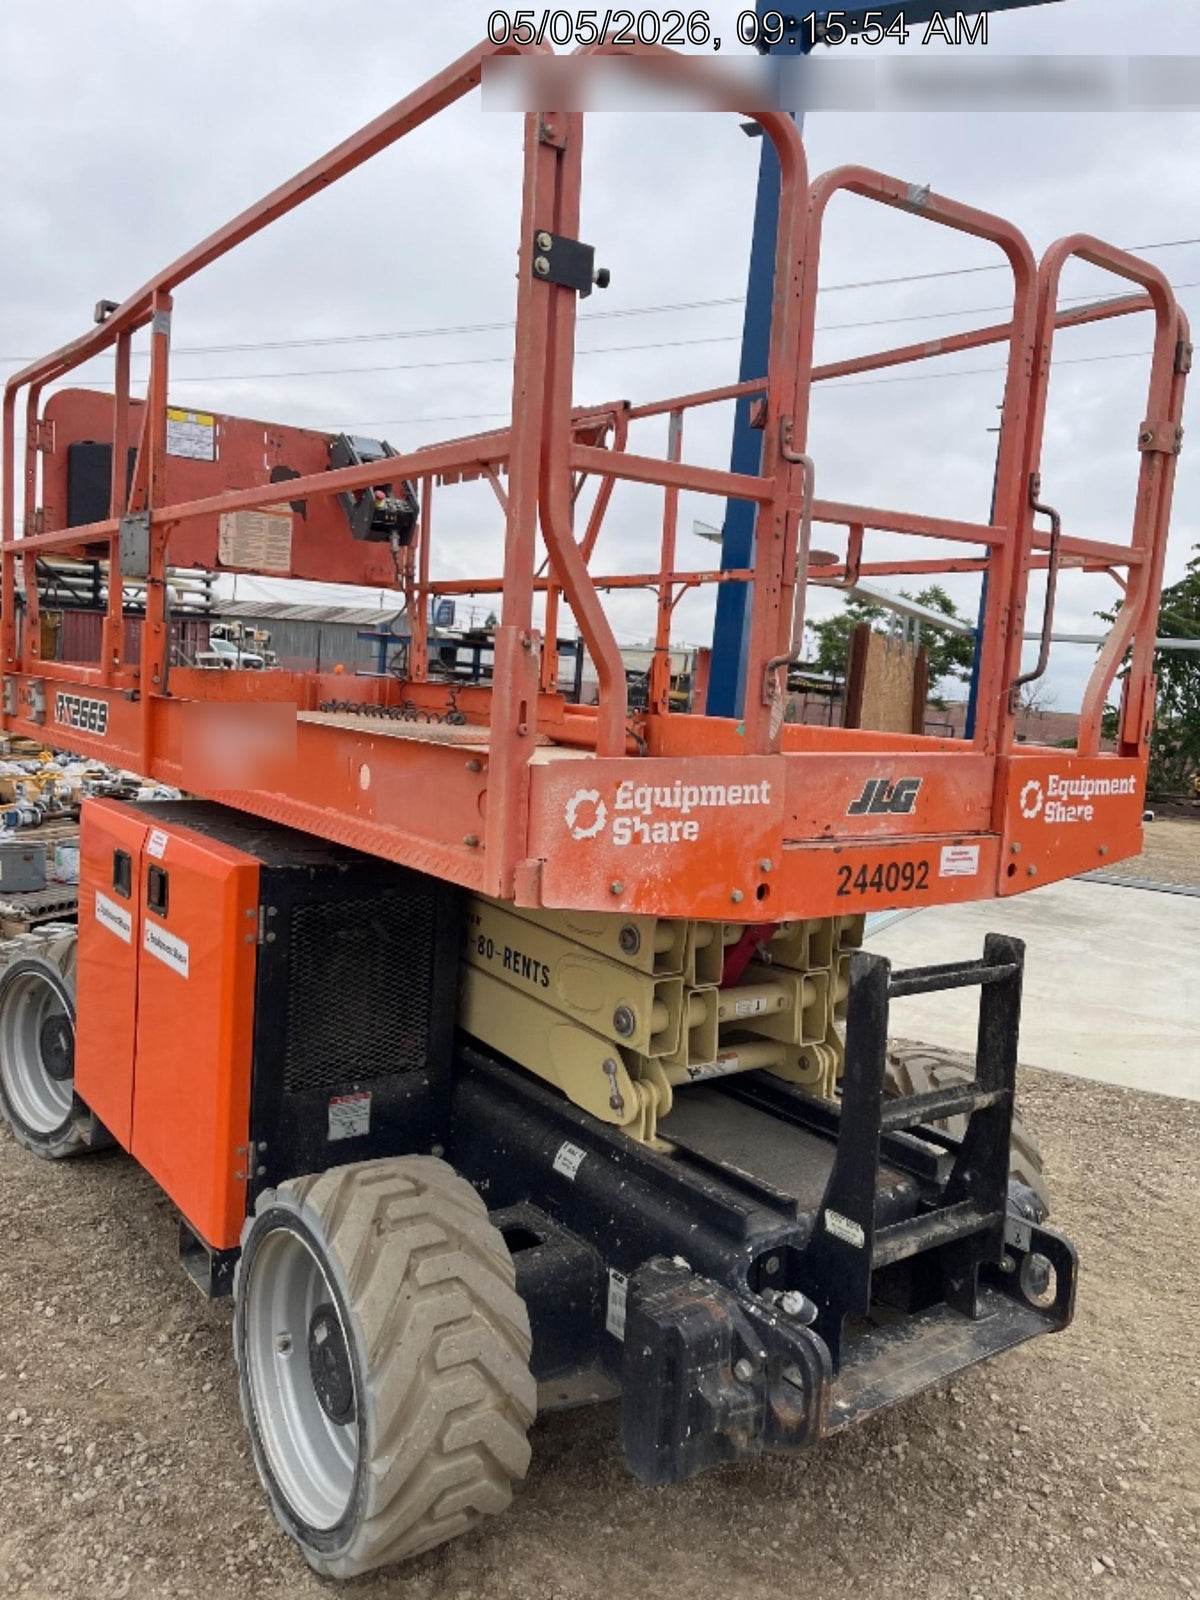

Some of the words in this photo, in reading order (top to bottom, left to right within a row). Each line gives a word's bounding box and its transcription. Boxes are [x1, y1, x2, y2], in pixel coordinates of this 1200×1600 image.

[614, 780, 771, 815] Equipment
[846, 777, 924, 816] JLG
[1047, 775, 1137, 801] Equipment
[1044, 801, 1094, 823] Share
[612, 816, 700, 846] Share
[836, 860, 929, 896] 244092
